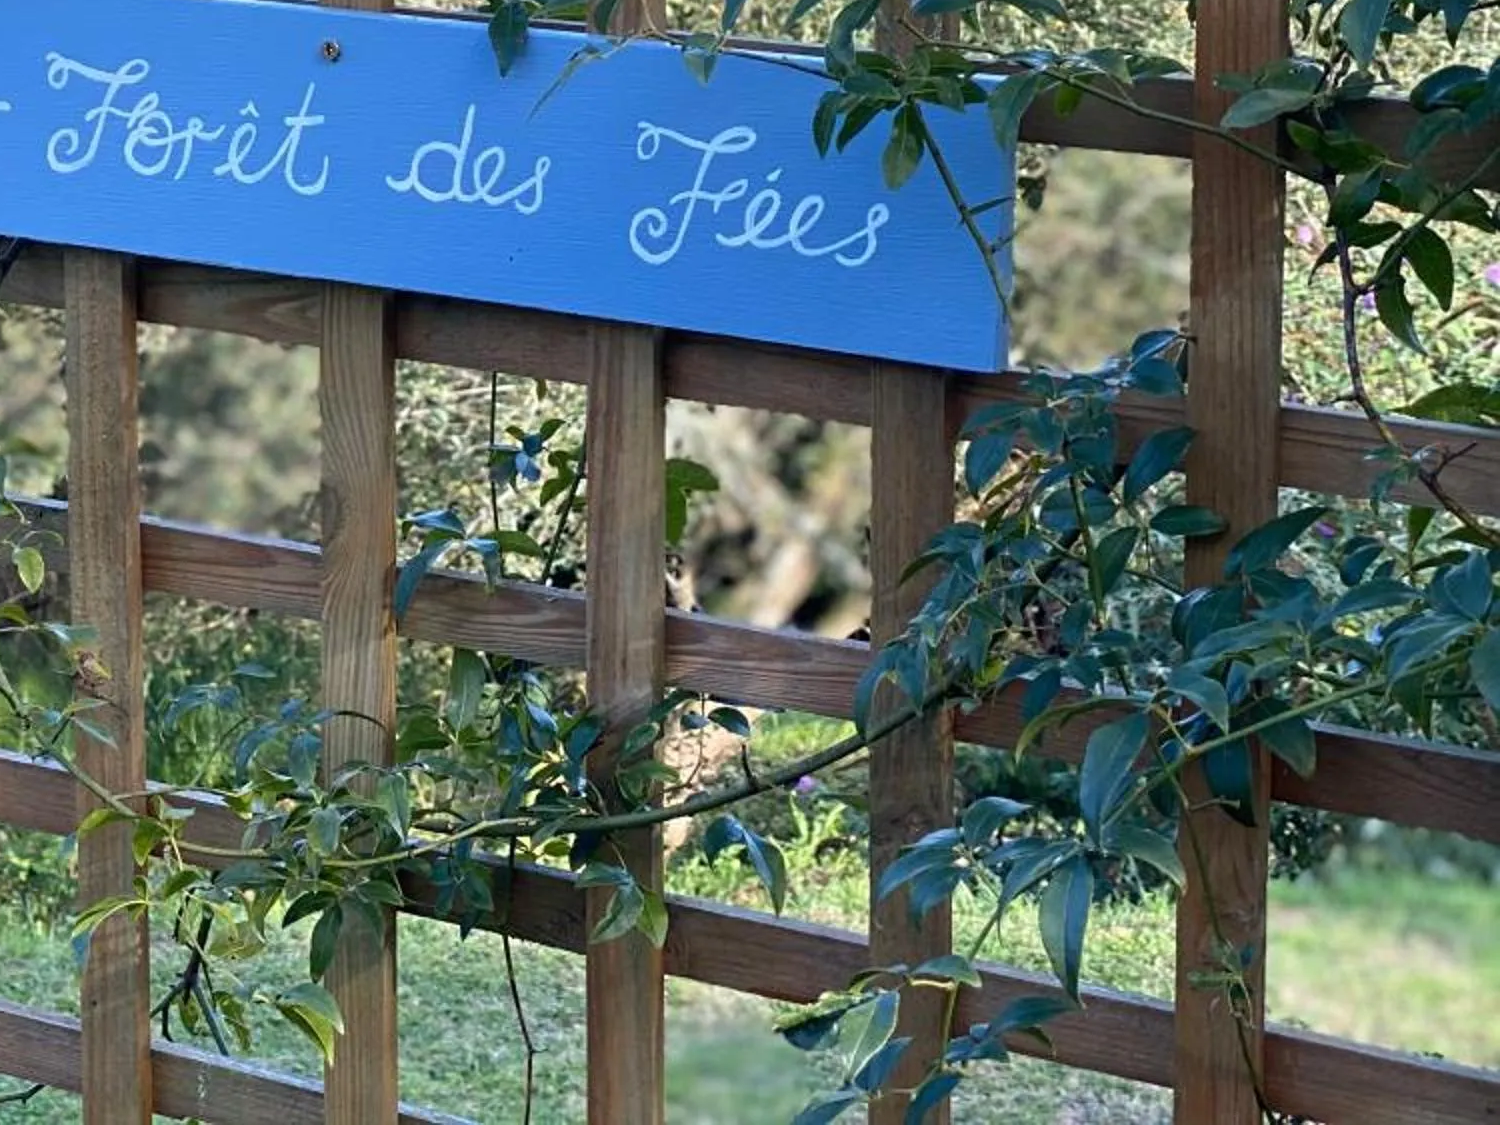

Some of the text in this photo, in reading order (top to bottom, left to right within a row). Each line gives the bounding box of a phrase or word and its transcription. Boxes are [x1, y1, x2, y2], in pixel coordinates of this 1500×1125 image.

[46, 52, 890, 267] Forêt des Fées
